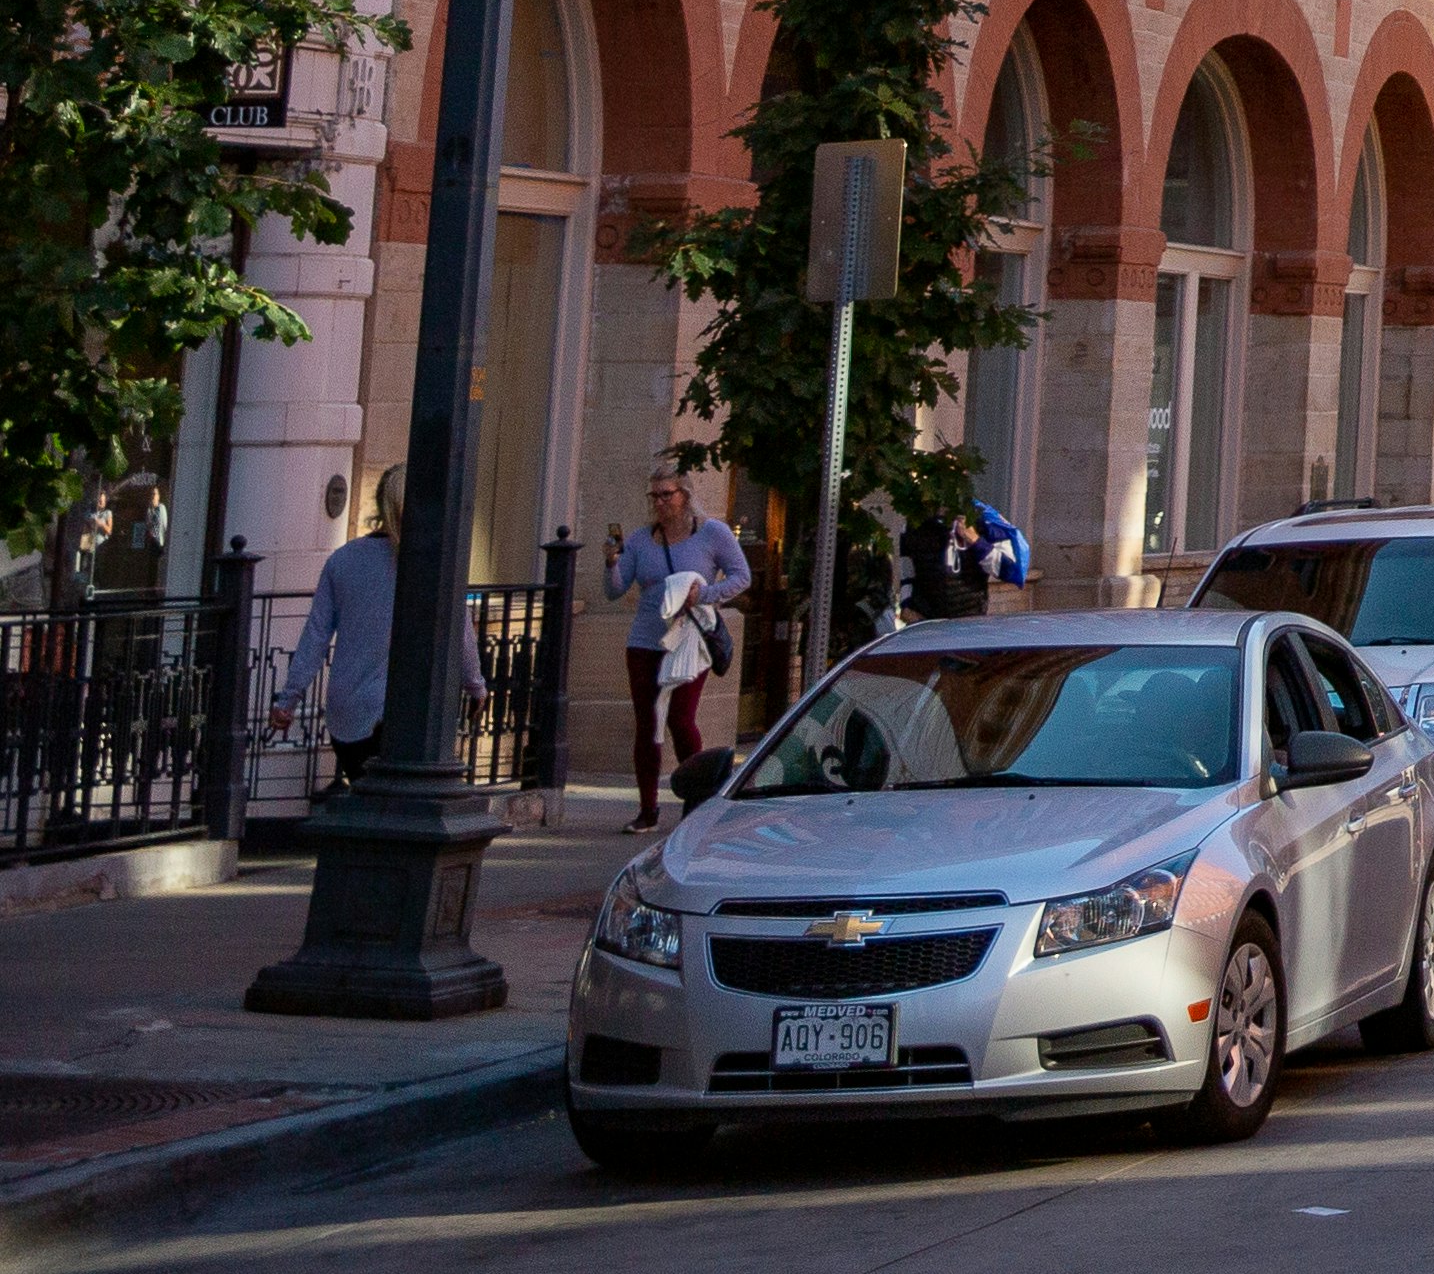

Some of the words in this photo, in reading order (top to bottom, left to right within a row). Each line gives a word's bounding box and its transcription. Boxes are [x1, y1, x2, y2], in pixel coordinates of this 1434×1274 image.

[210, 105, 269, 126] CLUB
[803, 1006, 867, 1017] MEDVED
[803, 1052, 860, 1062] COLORADO
